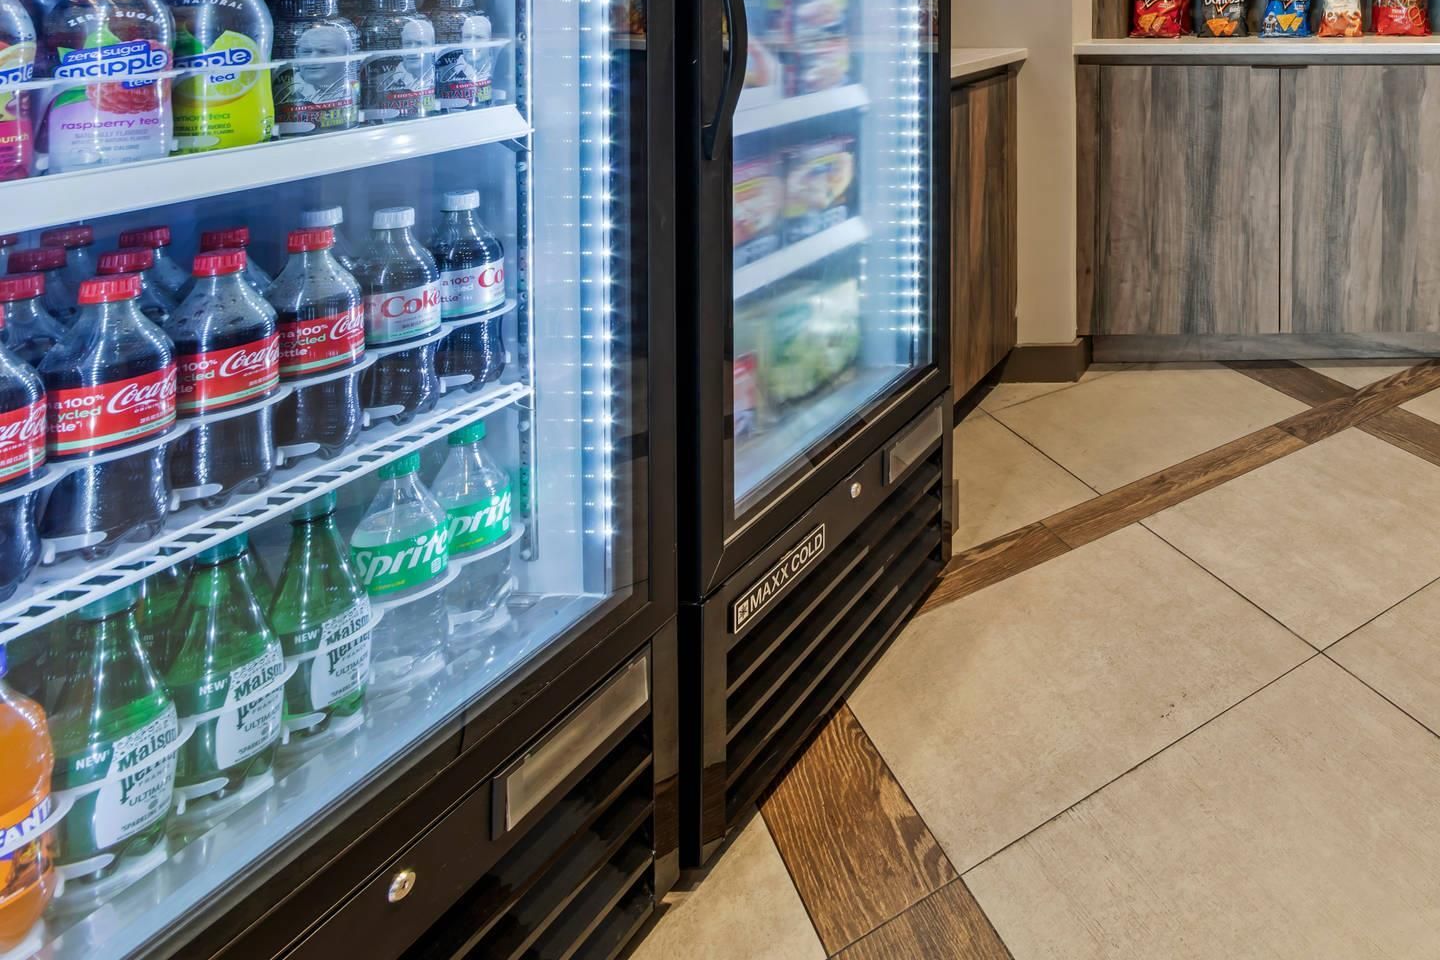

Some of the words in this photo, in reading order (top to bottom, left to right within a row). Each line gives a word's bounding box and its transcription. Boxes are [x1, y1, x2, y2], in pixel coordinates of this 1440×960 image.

[102, 43, 146, 57] sugar
[58, 50, 168, 78] snapple
[210, 73, 235, 83] tea
[60, 117, 136, 131] raspberry
[297, 323, 328, 337] 100%
[183, 359, 218, 372] 100%
[64, 393, 106, 409] 100%
[355, 525, 448, 586] Sprite
[750, 565, 789, 613] MAXX
[791, 533, 823, 574] COLD
[233, 662, 283, 702] Maison
[116, 727, 178, 773] Maison
